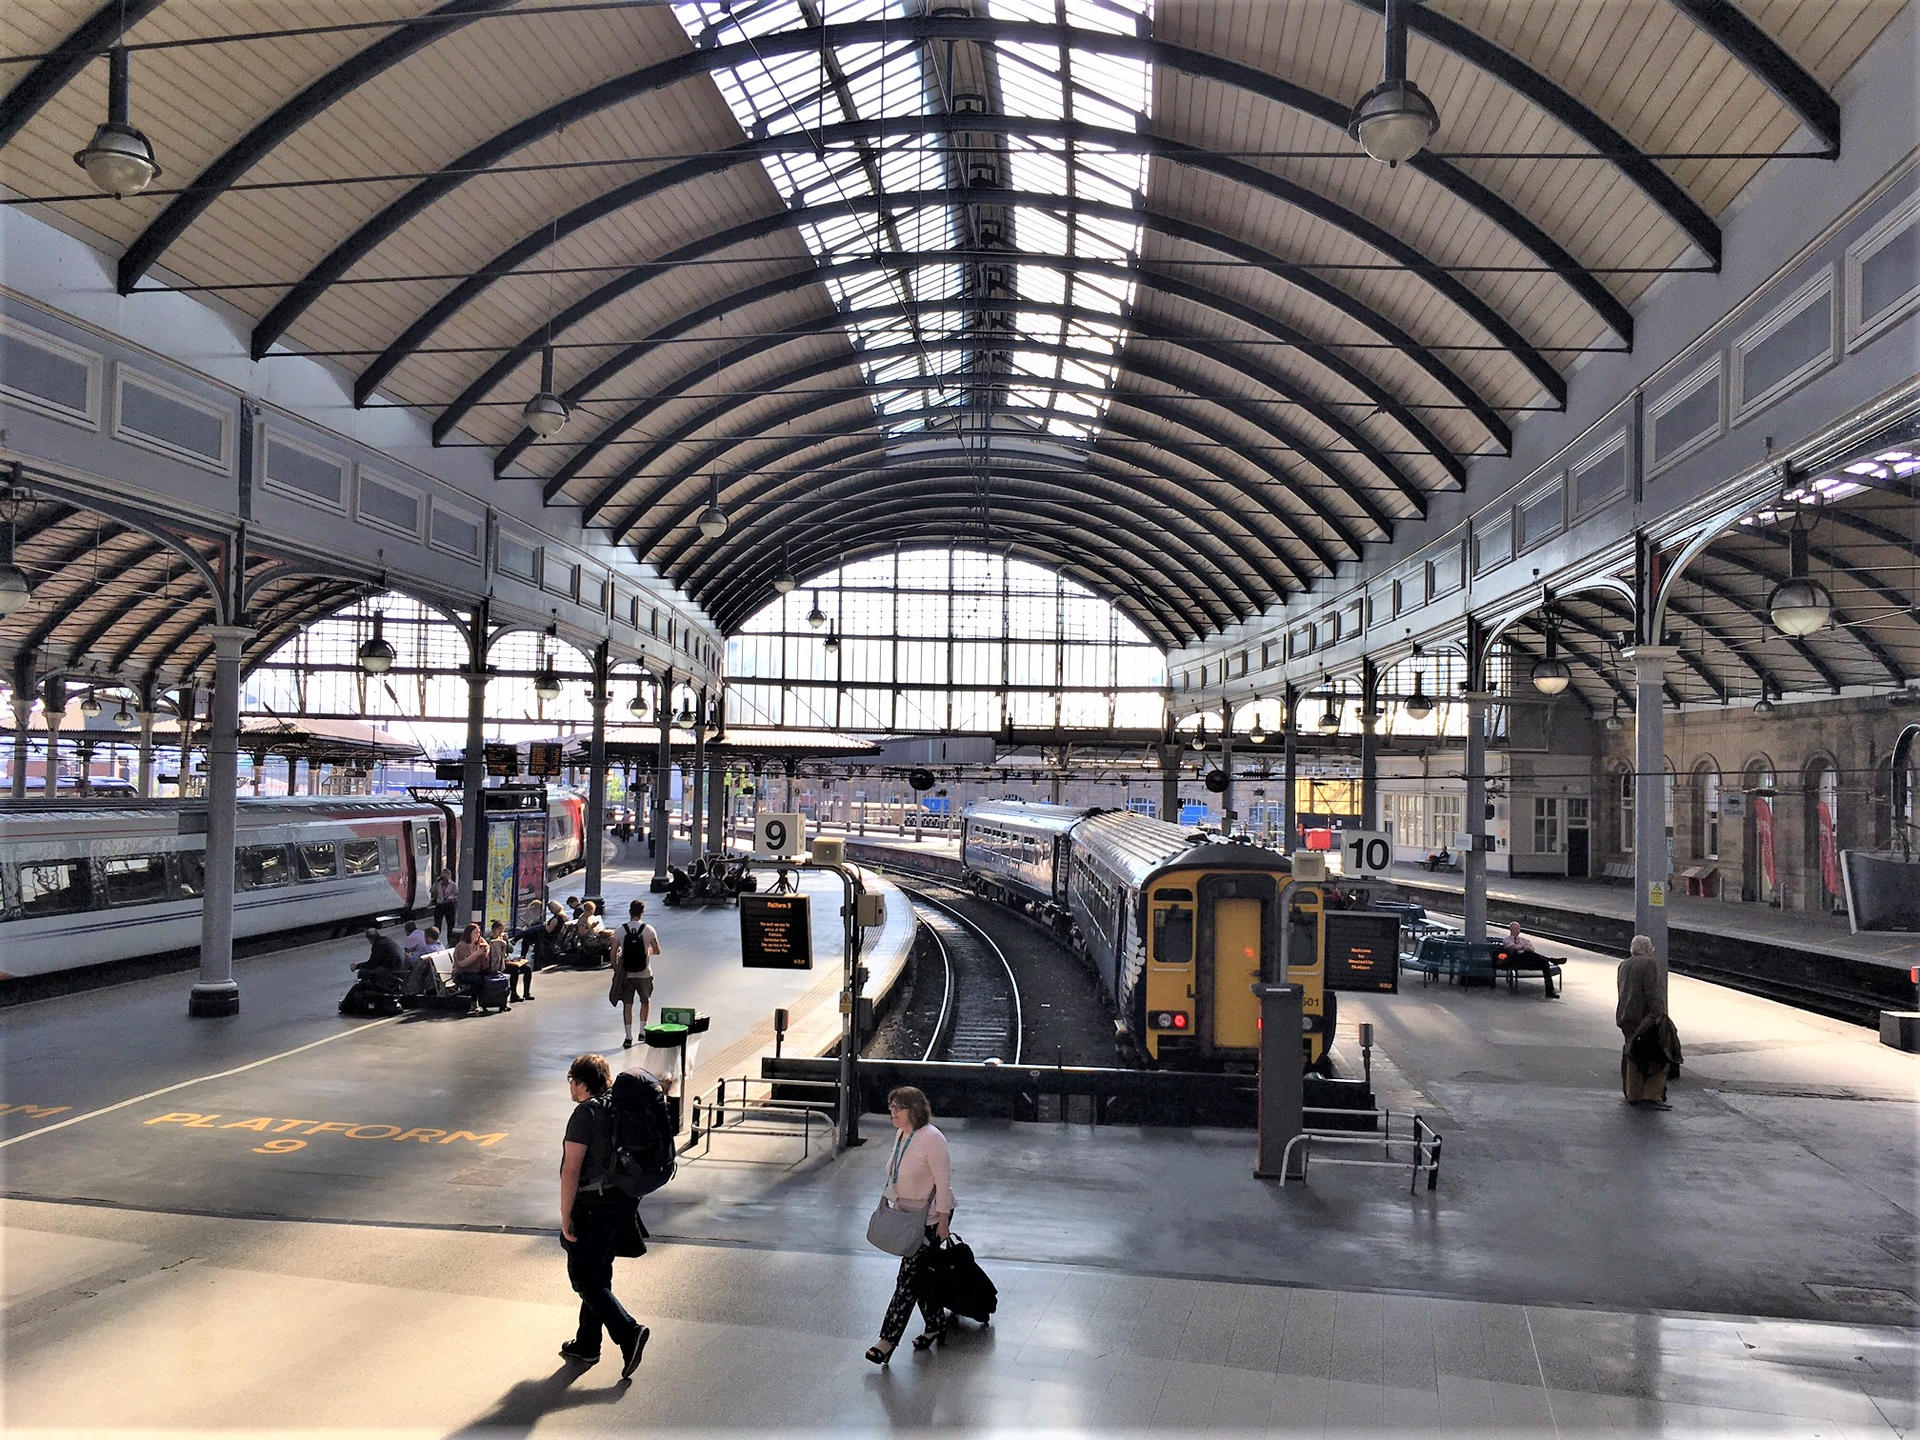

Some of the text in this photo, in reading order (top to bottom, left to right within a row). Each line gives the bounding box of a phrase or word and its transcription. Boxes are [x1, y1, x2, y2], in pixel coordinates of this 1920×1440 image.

[765, 820, 786, 850] 9
[1348, 838, 1390, 870] 10
[143, 1112, 510, 1147] PLATFORM
[252, 1138, 308, 1154] 9
